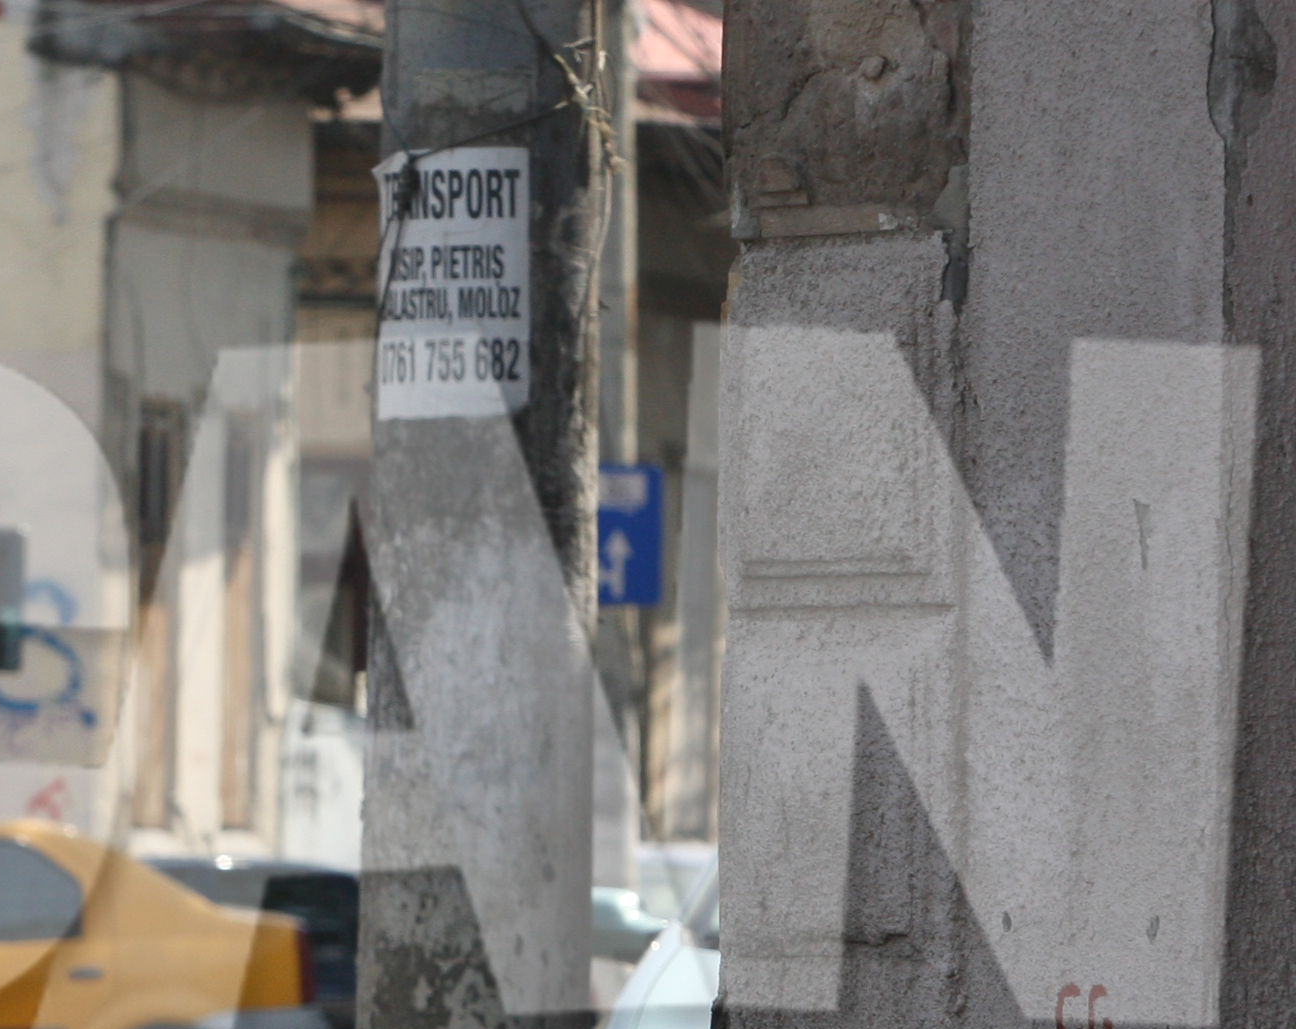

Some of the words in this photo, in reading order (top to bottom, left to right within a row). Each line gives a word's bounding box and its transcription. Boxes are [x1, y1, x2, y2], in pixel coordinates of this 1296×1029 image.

[458, 286, 521, 319] MOLOZ
[424, 337, 465, 383] 755
[475, 336, 521, 382] 682
